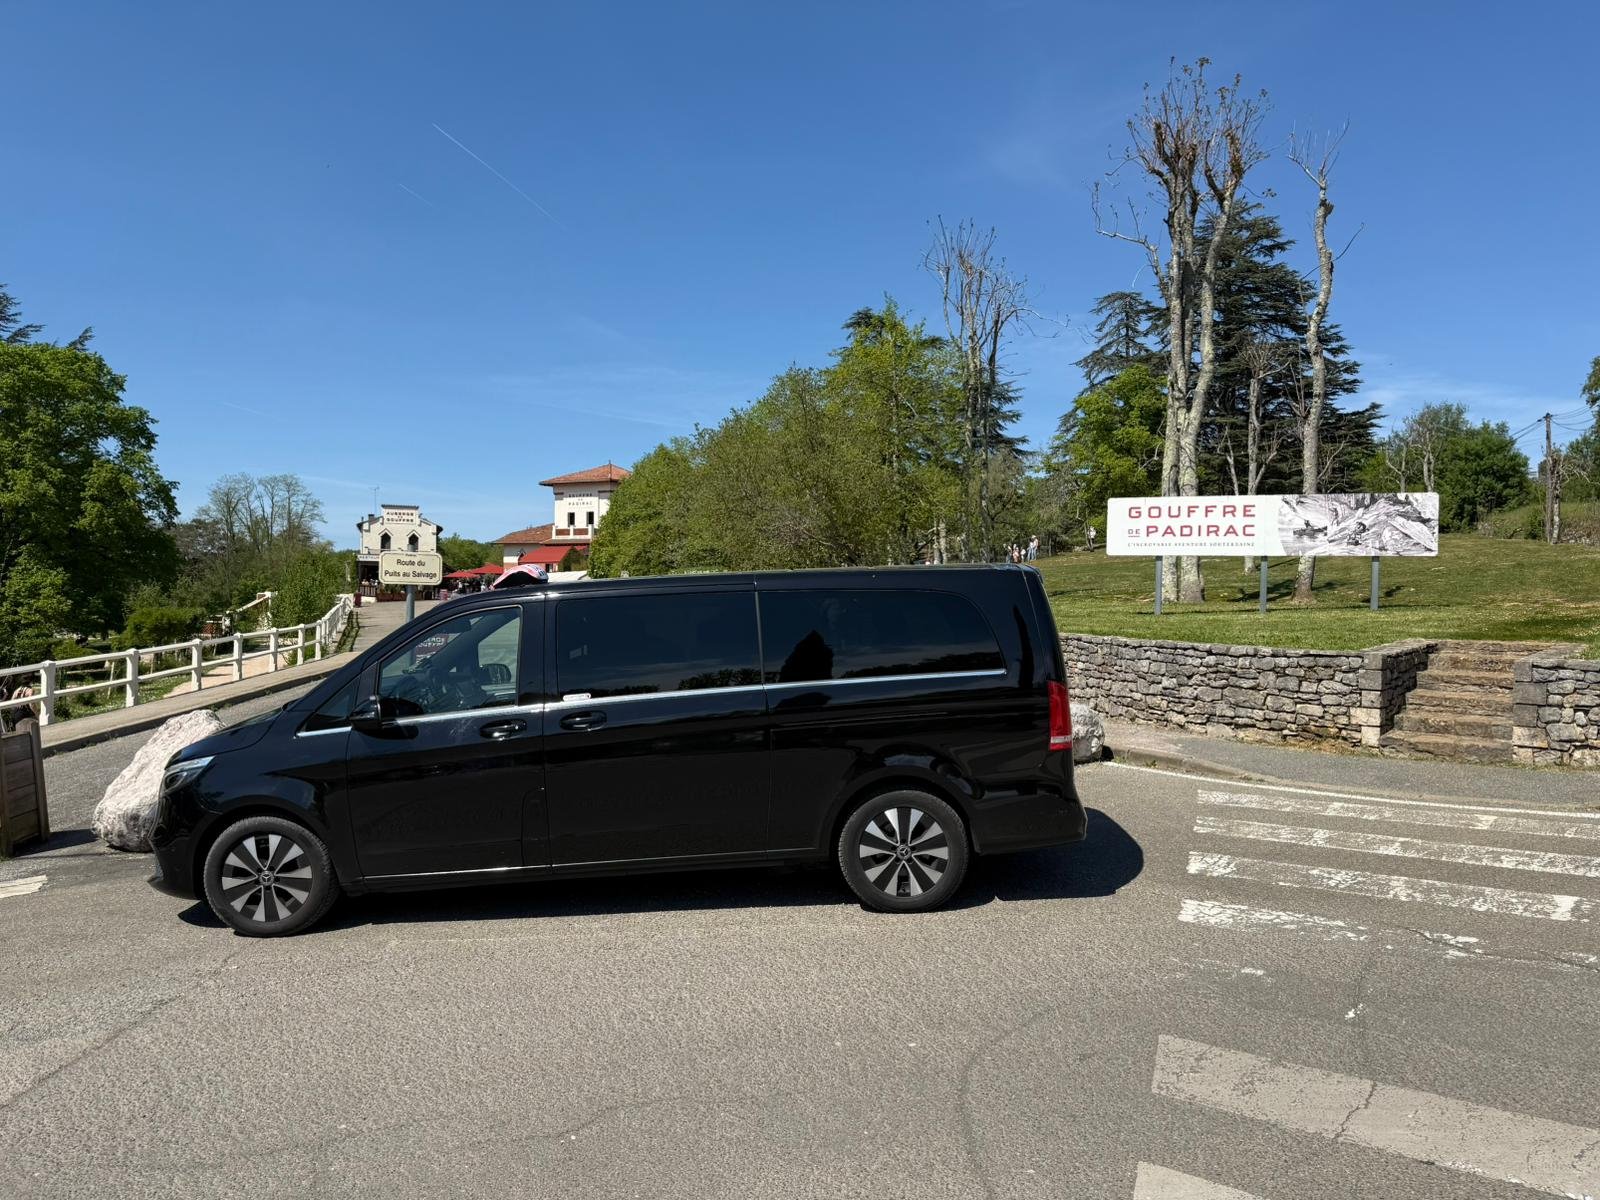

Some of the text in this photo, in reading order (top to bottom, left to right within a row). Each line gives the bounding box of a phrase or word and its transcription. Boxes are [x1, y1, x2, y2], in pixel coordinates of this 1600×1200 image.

[1128, 504, 1256, 519] GOUFFRE
[1146, 524, 1256, 537] PADIRAC
[417, 559, 426, 567] du
